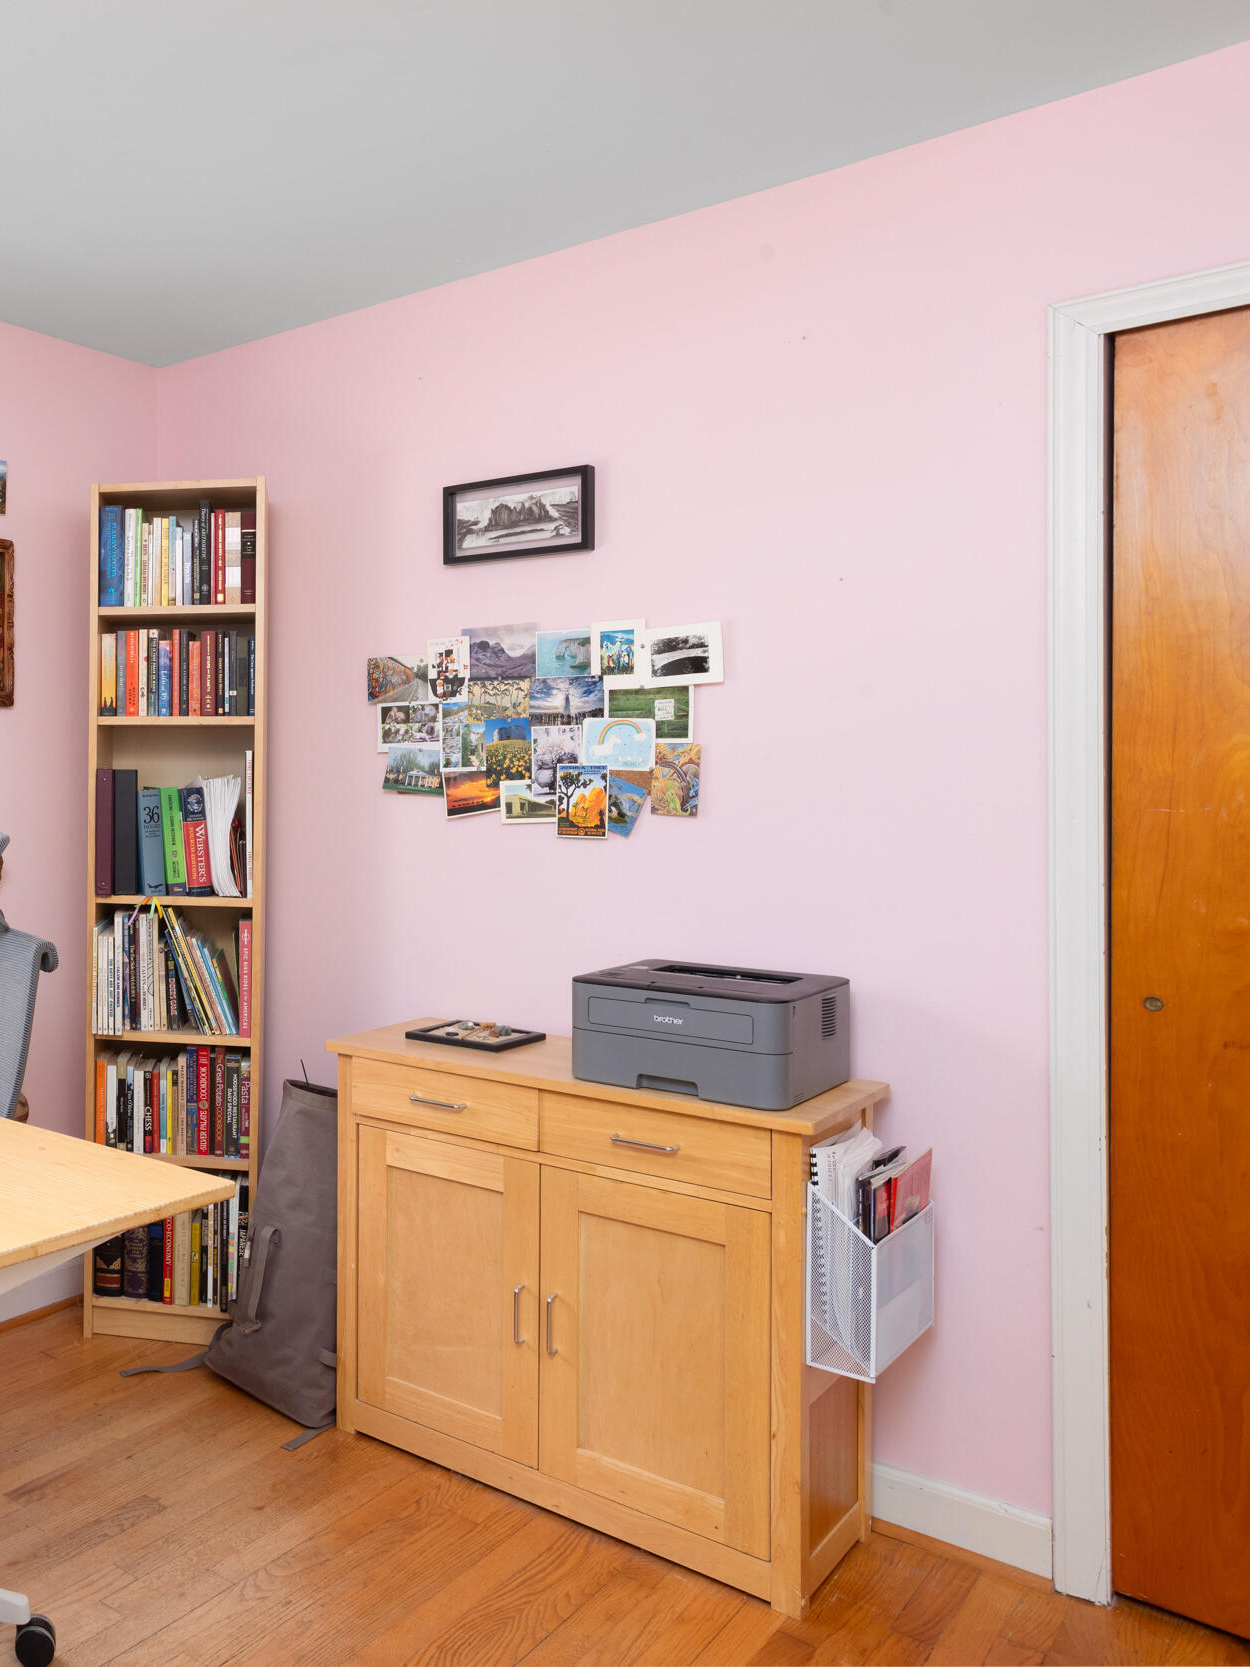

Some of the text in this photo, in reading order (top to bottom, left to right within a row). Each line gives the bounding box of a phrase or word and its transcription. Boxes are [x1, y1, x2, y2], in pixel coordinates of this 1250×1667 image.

[143, 805, 160, 824] 36
[195, 824, 207, 882] WEBSTER'S
[653, 1014, 684, 1025] brother
[241, 1081, 250, 1104] Pasta
